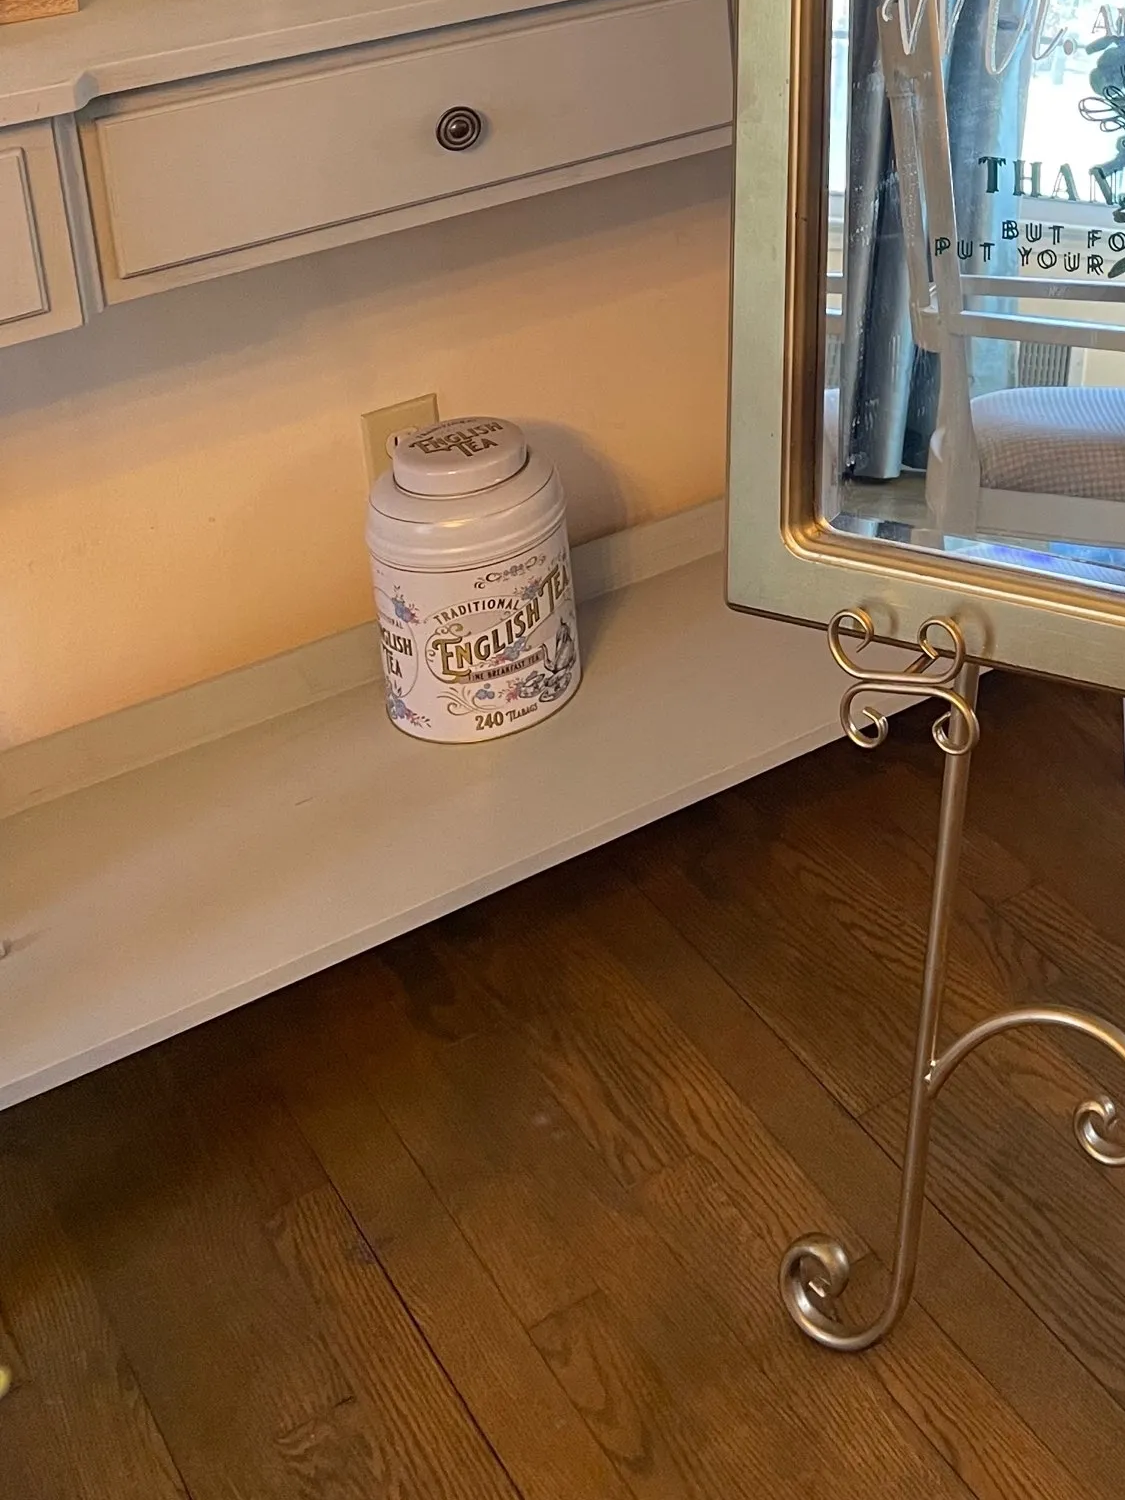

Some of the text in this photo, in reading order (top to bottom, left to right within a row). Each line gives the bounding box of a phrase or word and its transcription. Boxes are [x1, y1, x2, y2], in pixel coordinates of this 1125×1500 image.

[1001, 219, 1065, 246] BUT
[934, 236, 996, 263] PUT
[1017, 246, 1104, 276] YOUR
[408, 421, 504, 453] ENGLISH
[446, 438, 499, 457] TEA
[433, 599, 519, 625] TRADITIONAL
[432, 597, 540, 677] ENGLISH
[475, 711, 504, 731] 240
